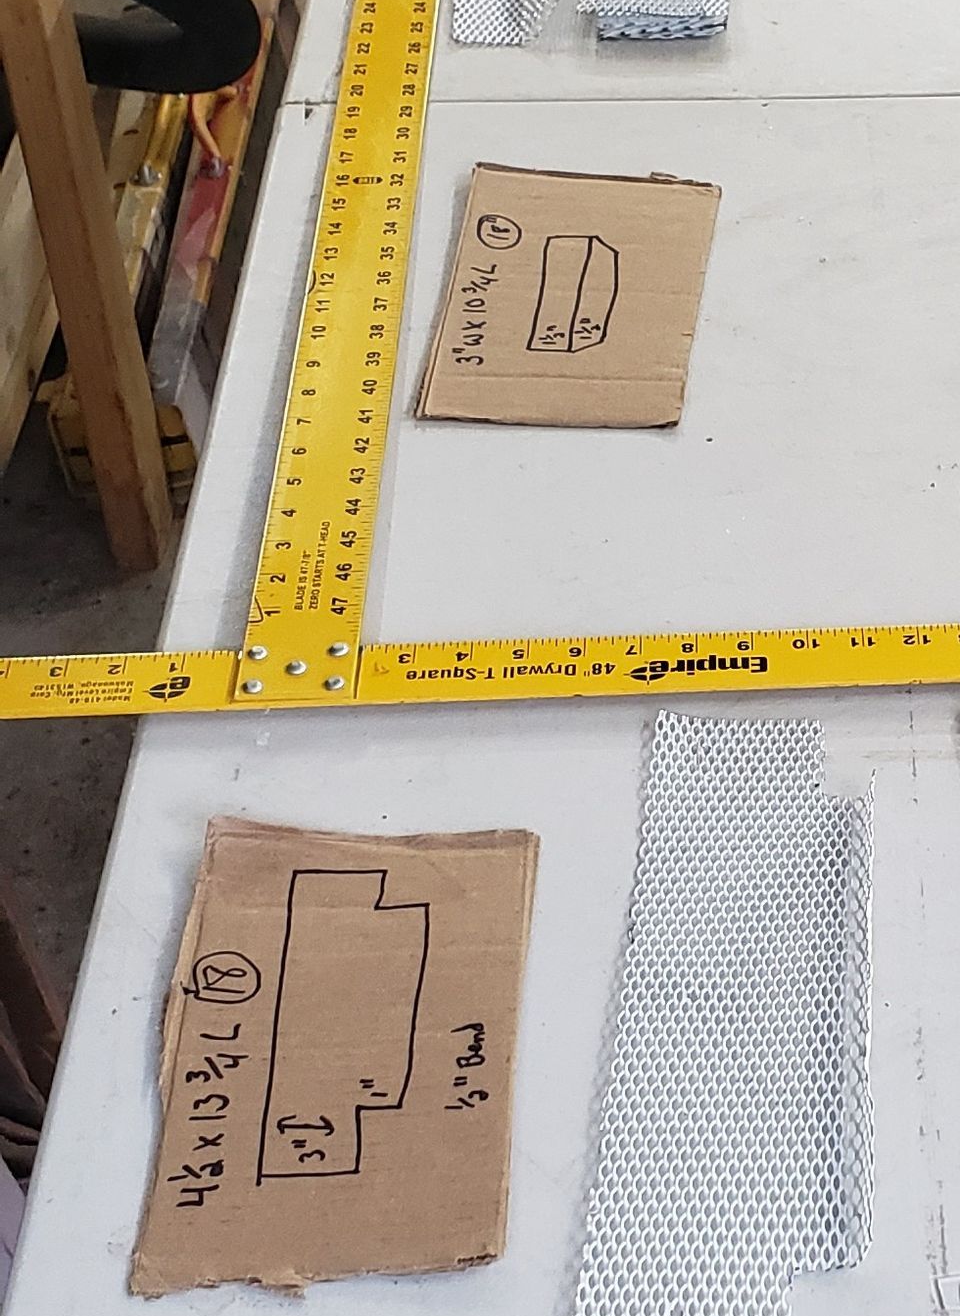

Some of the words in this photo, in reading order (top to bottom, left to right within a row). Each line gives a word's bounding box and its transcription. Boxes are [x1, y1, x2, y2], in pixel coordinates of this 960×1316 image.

[363, 3, 376, 13] 24
[413, 2, 426, 13] 24
[360, 22, 373, 34] 23
[410, 22, 424, 33] 25
[357, 43, 371, 54] 22
[408, 42, 421, 54] 26
[354, 64, 367, 75] 21
[405, 63, 418, 75] 27
[350, 85, 364, 97] 20
[402, 84, 415, 96] 28
[345, 106, 360, 118] 19
[399, 106, 413, 118] 29
[343, 128, 357, 140] 18
[396, 127, 410, 139] 30
[339, 152, 353, 164] 17
[393, 151, 407, 163] 31
[335, 175, 350, 187] 16
[390, 173, 404, 186] 32
[331, 198, 346, 211] 15
[386, 197, 401, 210] 33
[327, 222, 342, 235] 14
[383, 222, 398, 235] 34
[323, 247, 339, 261] 13
[379, 246, 395, 260] 35
[319, 273, 335, 286] 12
[376, 271, 391, 285] 36
[315, 299, 331, 313] 11
[373, 297, 388, 311] 37
[311, 325, 326, 340] 10
[369, 325, 384, 339] 38
[306, 360, 320, 368] 9
[365, 352, 381, 366] 39
[362, 379, 378, 395] 40
[358, 409, 374, 424] 41
[353, 438, 370, 453] 42
[286, 478, 302, 486] 5
[349, 468, 366, 484] 43
[281, 509, 297, 517] 4
[345, 498, 361, 516] 44
[340, 530, 357, 548] 45
[275, 542, 291, 550] 3
[312, 560, 325, 587] STARTS
[335, 563, 352, 581] 46
[270, 574, 285, 583] 2
[294, 585, 306, 610] BLADE
[309, 590, 320, 610] ZERO
[331, 597, 348, 615] 47
[737, 640, 750, 651] 9
[792, 638, 820, 649] 10
[850, 636, 876, 648] 11
[903, 634, 931, 645] 12
[568, 646, 582, 657] 6
[625, 644, 637, 655] 7
[681, 642, 694, 653] 8
[398, 653, 411, 664] 3
[456, 651, 470, 661] 4
[512, 648, 525, 660] 5
[108, 664, 122, 674] 2
[169, 662, 179, 672] 1
[502, 663, 577, 679] Drywall
[584, 662, 616, 677] 48"
[649, 655, 768, 675] Empire
[50, 666, 63, 677] 3
[406, 667, 494, 681] T-Square
[100, 688, 133, 696] Empire
[450, 1023, 485, 1069] Bend
